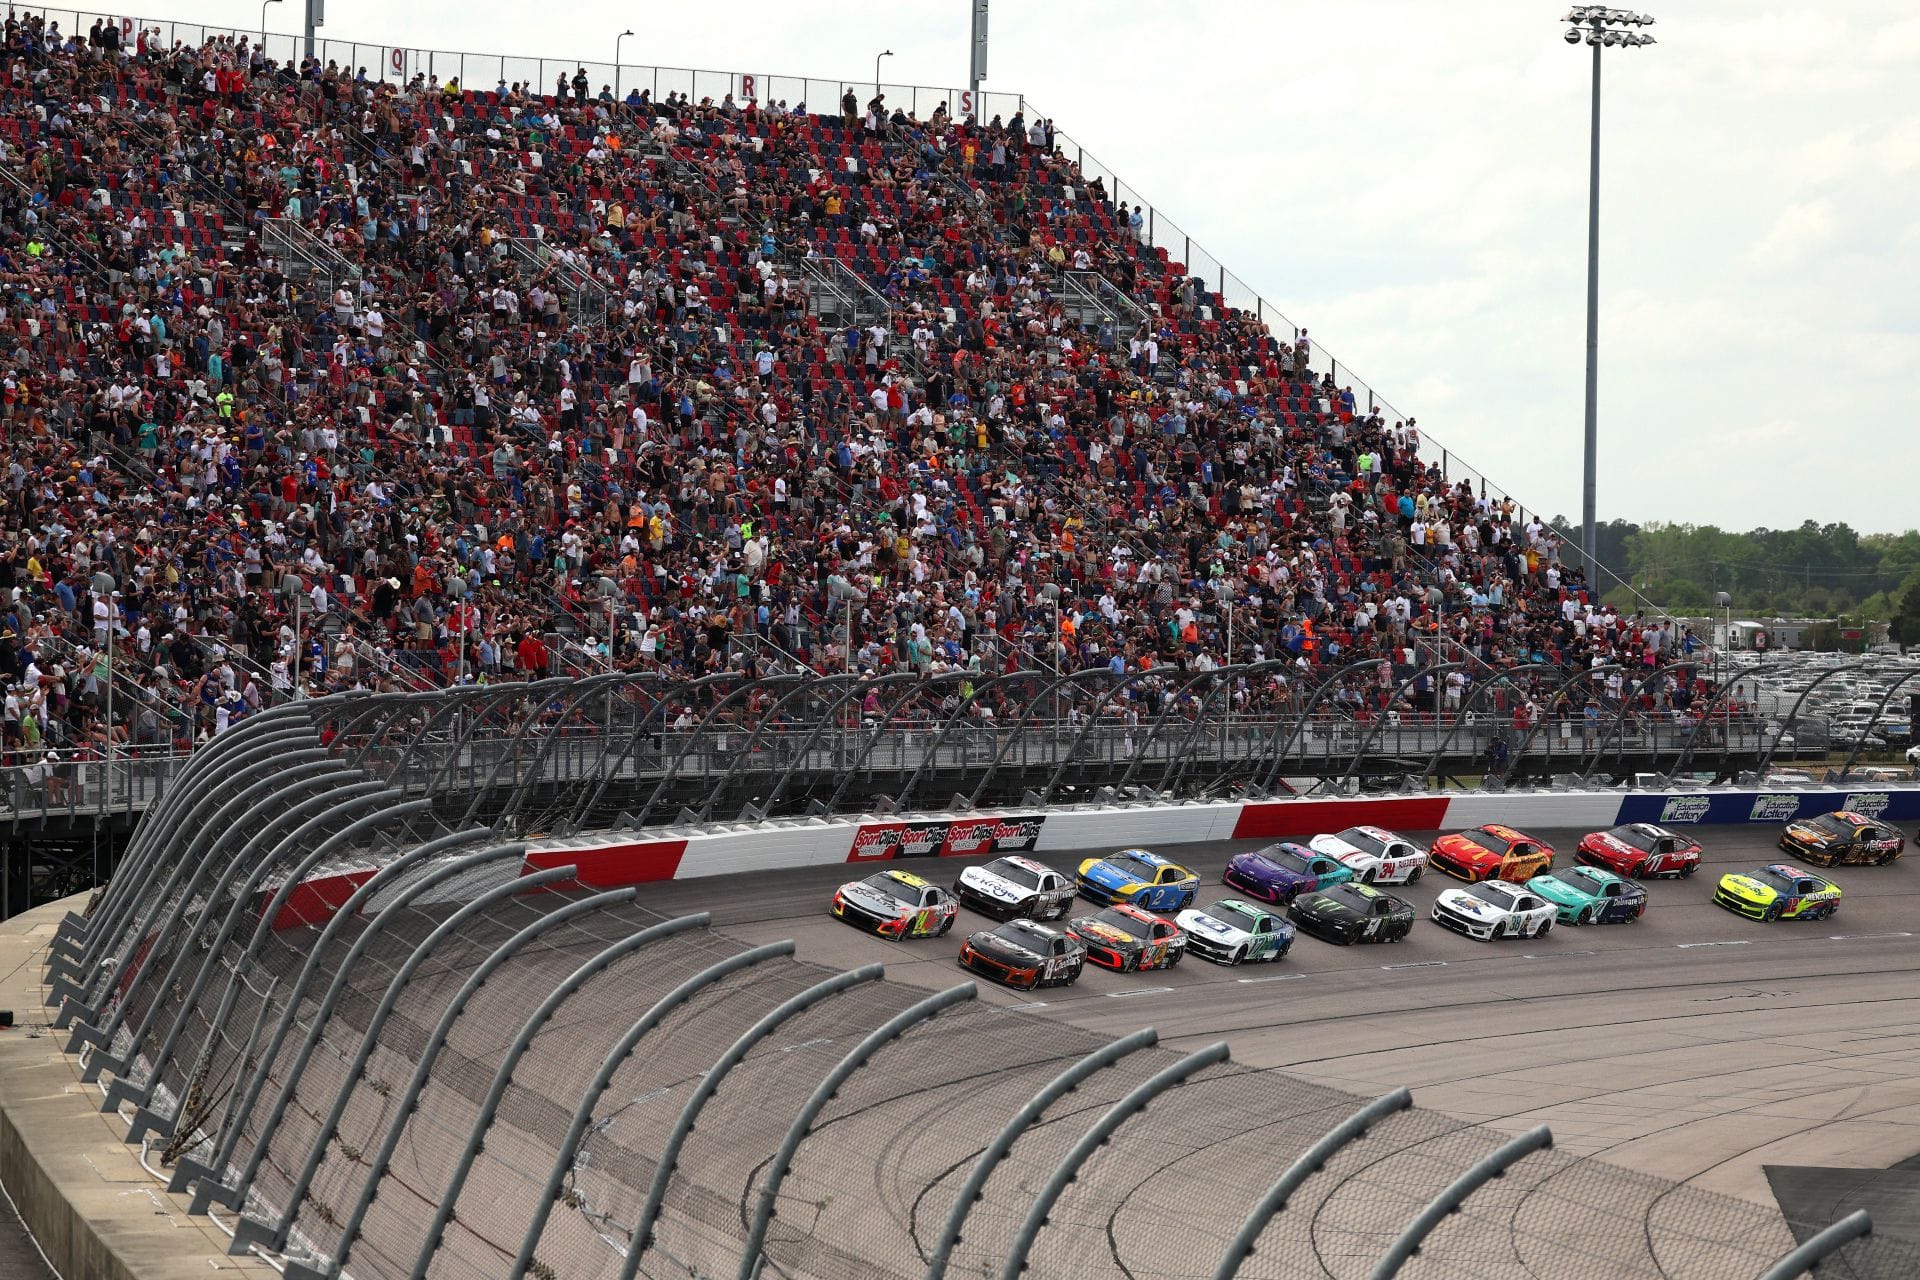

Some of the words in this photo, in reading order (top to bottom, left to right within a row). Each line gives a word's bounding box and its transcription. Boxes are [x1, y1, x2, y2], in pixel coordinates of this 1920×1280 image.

[122, 18, 132, 41] P
[392, 49, 402, 71] Q
[743, 76, 754, 96] R
[962, 92, 971, 112] S
[1674, 811, 1701, 820] Lottery
[1677, 803, 1708, 811] Education
[1763, 809, 1791, 819] Lottery
[1379, 863, 1395, 878] 34
[1152, 889, 1165, 906] 2
[1510, 916, 1520, 931] 38
[1044, 958, 1055, 980] 8
